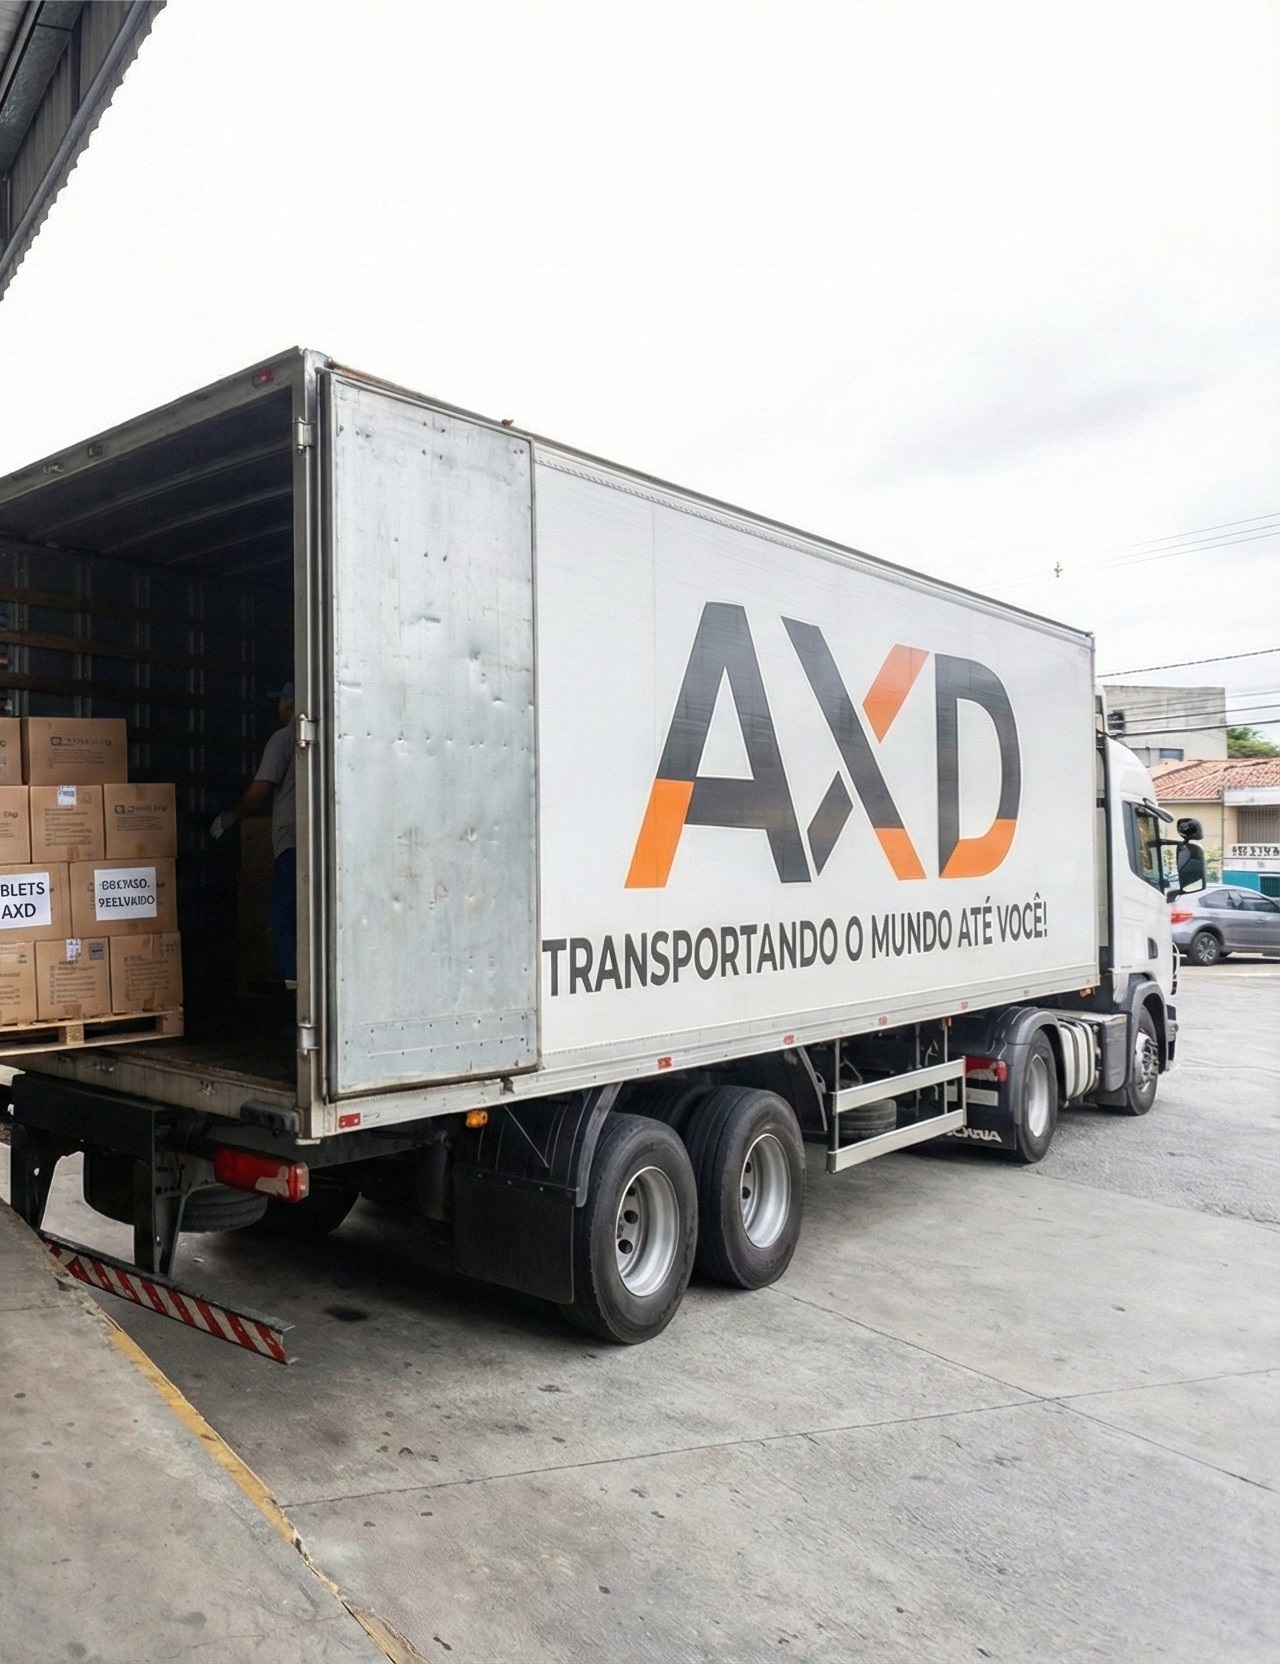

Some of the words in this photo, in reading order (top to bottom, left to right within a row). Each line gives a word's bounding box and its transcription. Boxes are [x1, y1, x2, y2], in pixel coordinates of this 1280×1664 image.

[624, 601, 1021, 888] AXD
[0, 903, 37, 920] AXD
[542, 917, 838, 997] TRANSPORTANDO
[845, 916, 863, 962] O
[871, 909, 952, 959] MUNDO
[957, 896, 993, 948] ATÉ
[997, 892, 1048, 942] VOCÊ!
